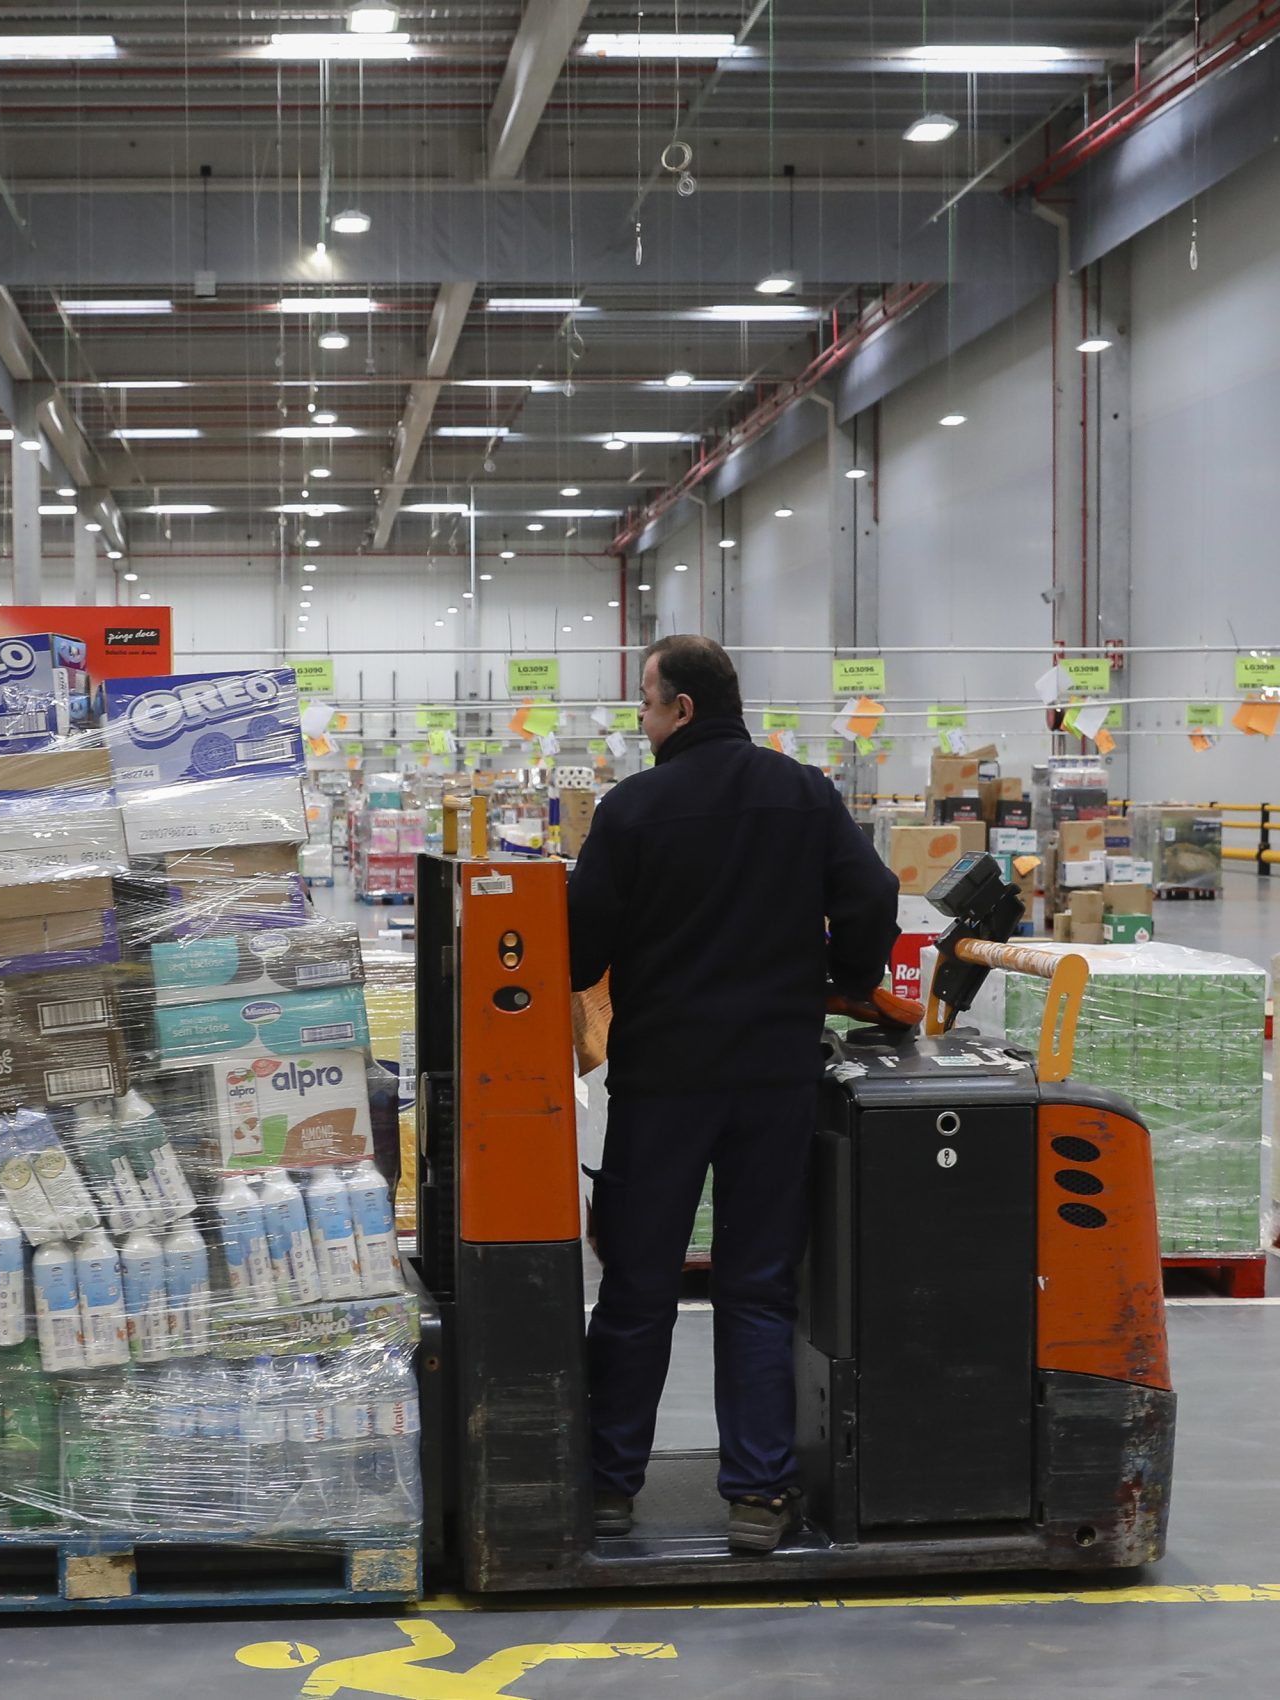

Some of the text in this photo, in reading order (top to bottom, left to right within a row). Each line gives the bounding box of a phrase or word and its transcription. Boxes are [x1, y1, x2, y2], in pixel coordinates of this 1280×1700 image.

[107, 629, 158, 644] pingo doce
[296, 667, 324, 675] G3090
[517, 665, 549, 673] LG3092
[130, 675, 278, 735] OREO
[245, 1005, 281, 1017] Mimosa
[172, 1023, 231, 1038] sem lactose
[271, 1061, 343, 1097] alpro
[229, 1086, 256, 1098] alpro
[301, 1124, 335, 1141] ALMOND
[311, 1312, 334, 1323] UM
[299, 1317, 350, 1336] BONGO
[392, 1401, 405, 1436] Vitalis
